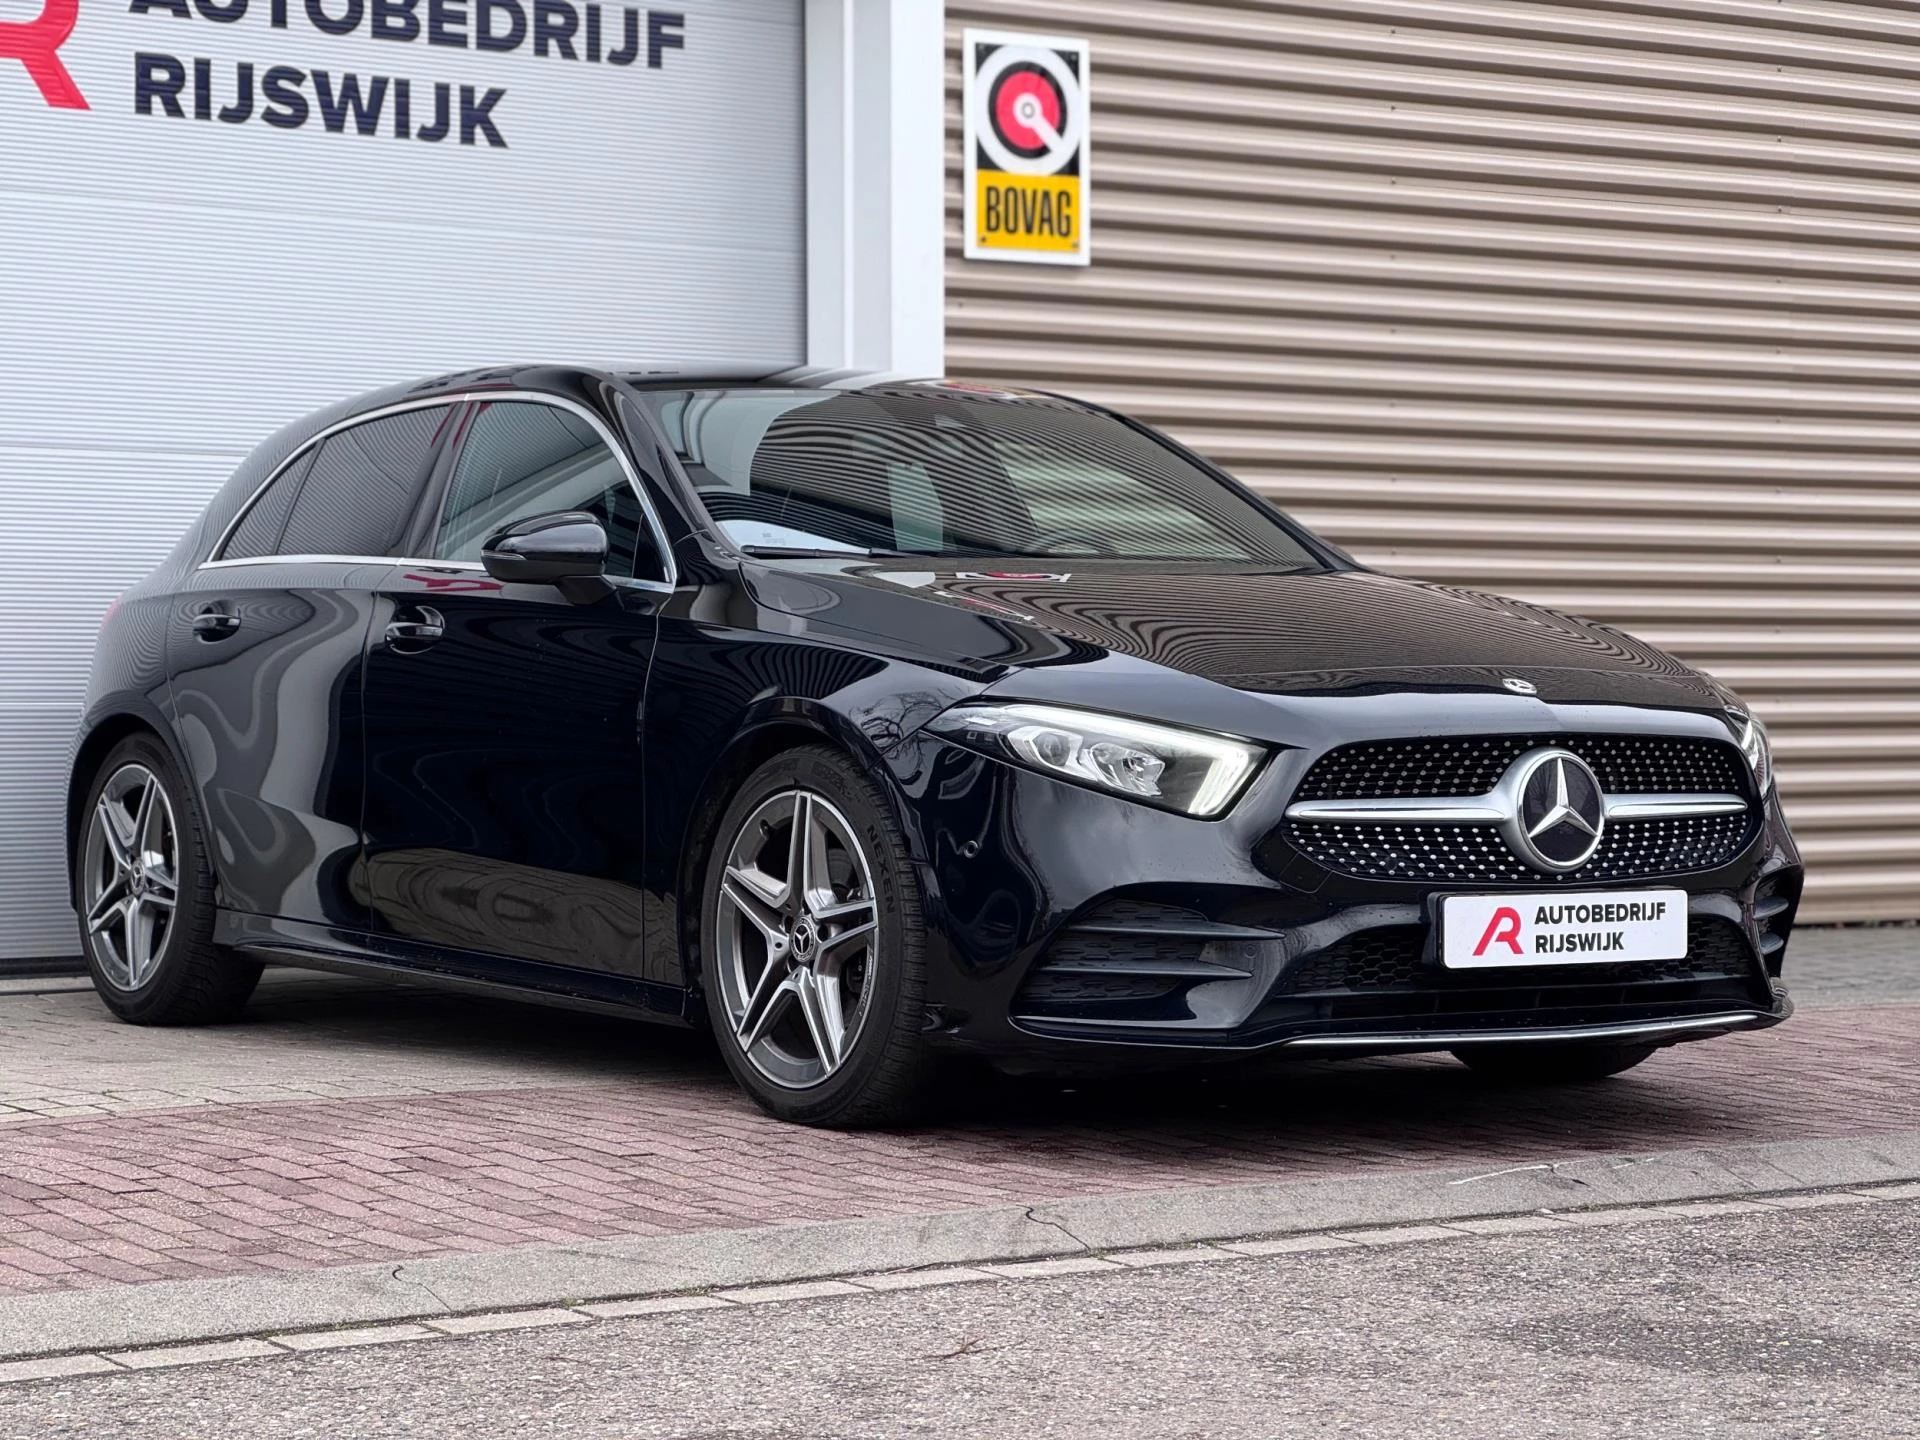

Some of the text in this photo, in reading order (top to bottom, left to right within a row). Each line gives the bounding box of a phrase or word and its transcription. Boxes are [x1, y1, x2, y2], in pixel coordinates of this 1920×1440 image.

[128, 0, 685, 69] OBEDRIJF
[134, 51, 509, 149] RIJSWIJK
[985, 186, 1072, 238] BOVAG
[866, 824, 895, 914] NEXEN
[1534, 902, 1667, 925] AUTOBEDRIJF
[1535, 931, 1625, 954] RIJSWIJK
